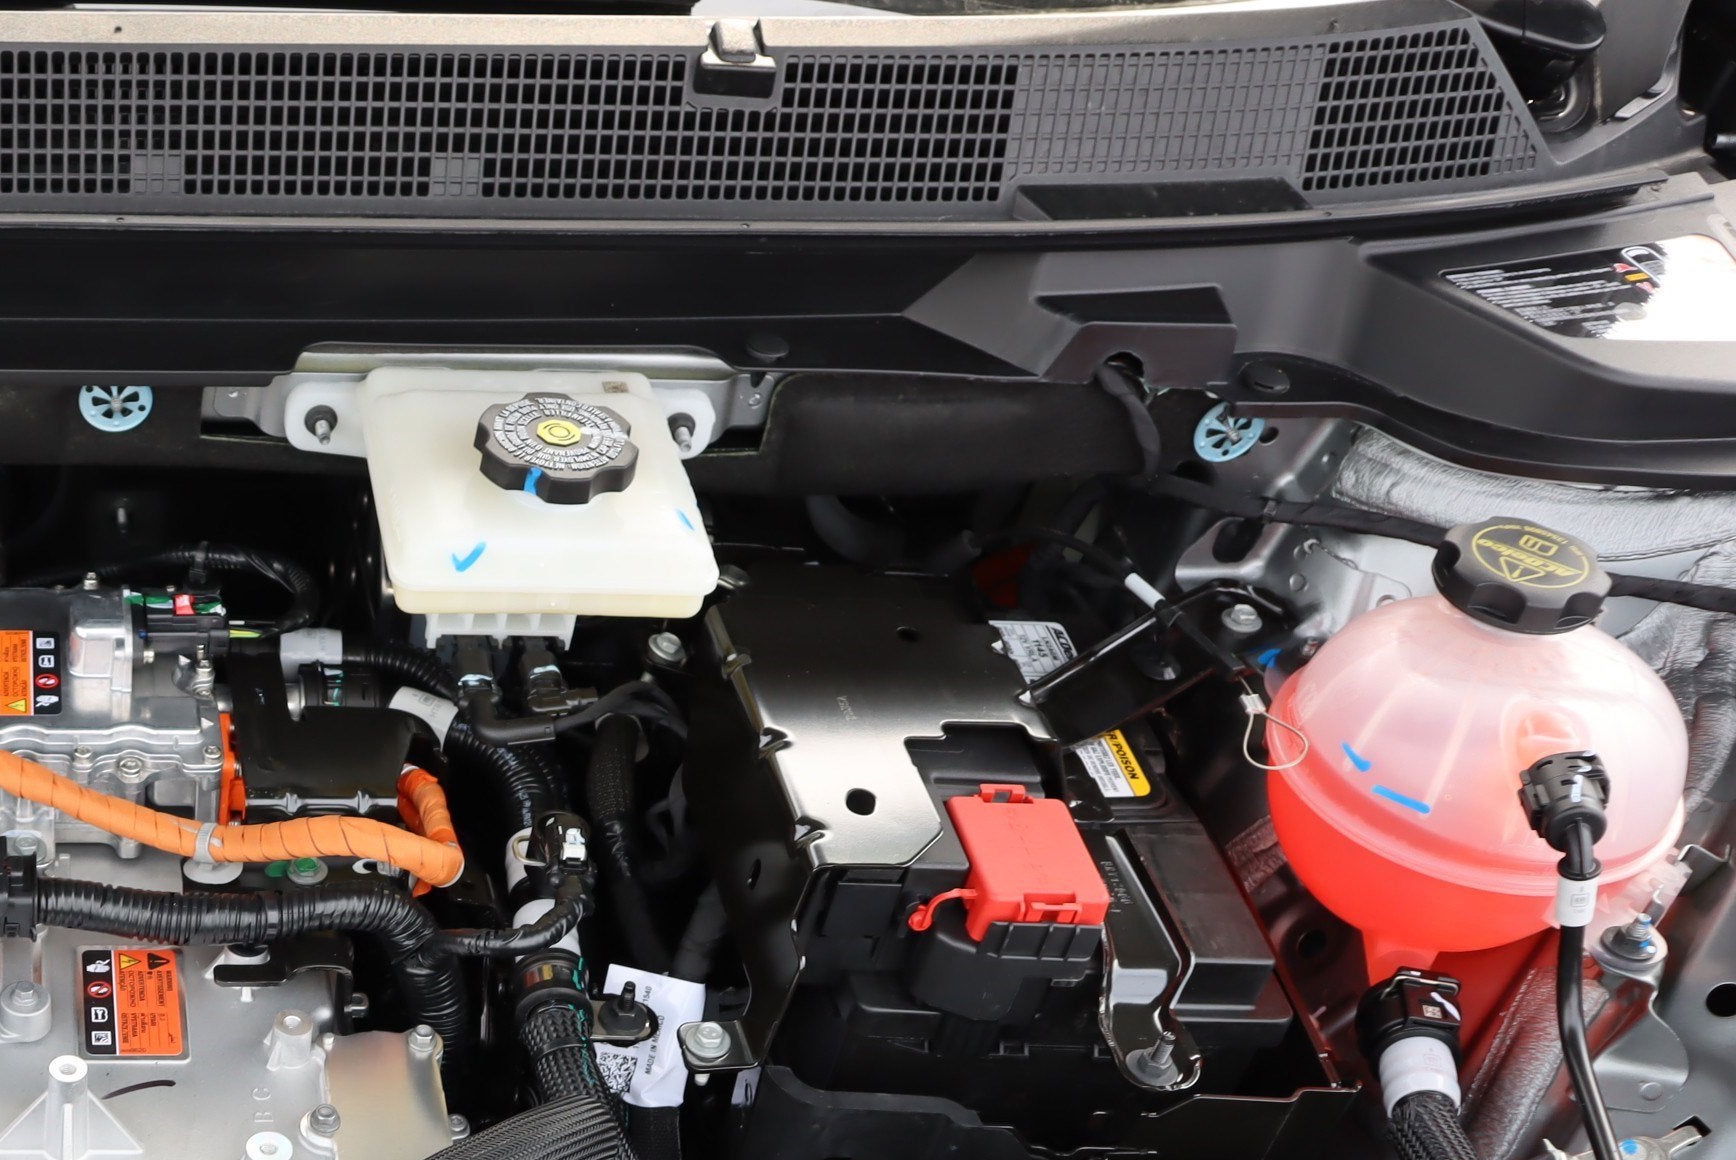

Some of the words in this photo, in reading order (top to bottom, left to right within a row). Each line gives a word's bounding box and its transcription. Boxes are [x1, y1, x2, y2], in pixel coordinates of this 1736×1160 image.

[1476, 539, 1583, 578] ACDelco
[1051, 628, 1075, 660] ACDe
[644, 1055, 656, 1075] MADE
[650, 1043, 659, 1053] IN
